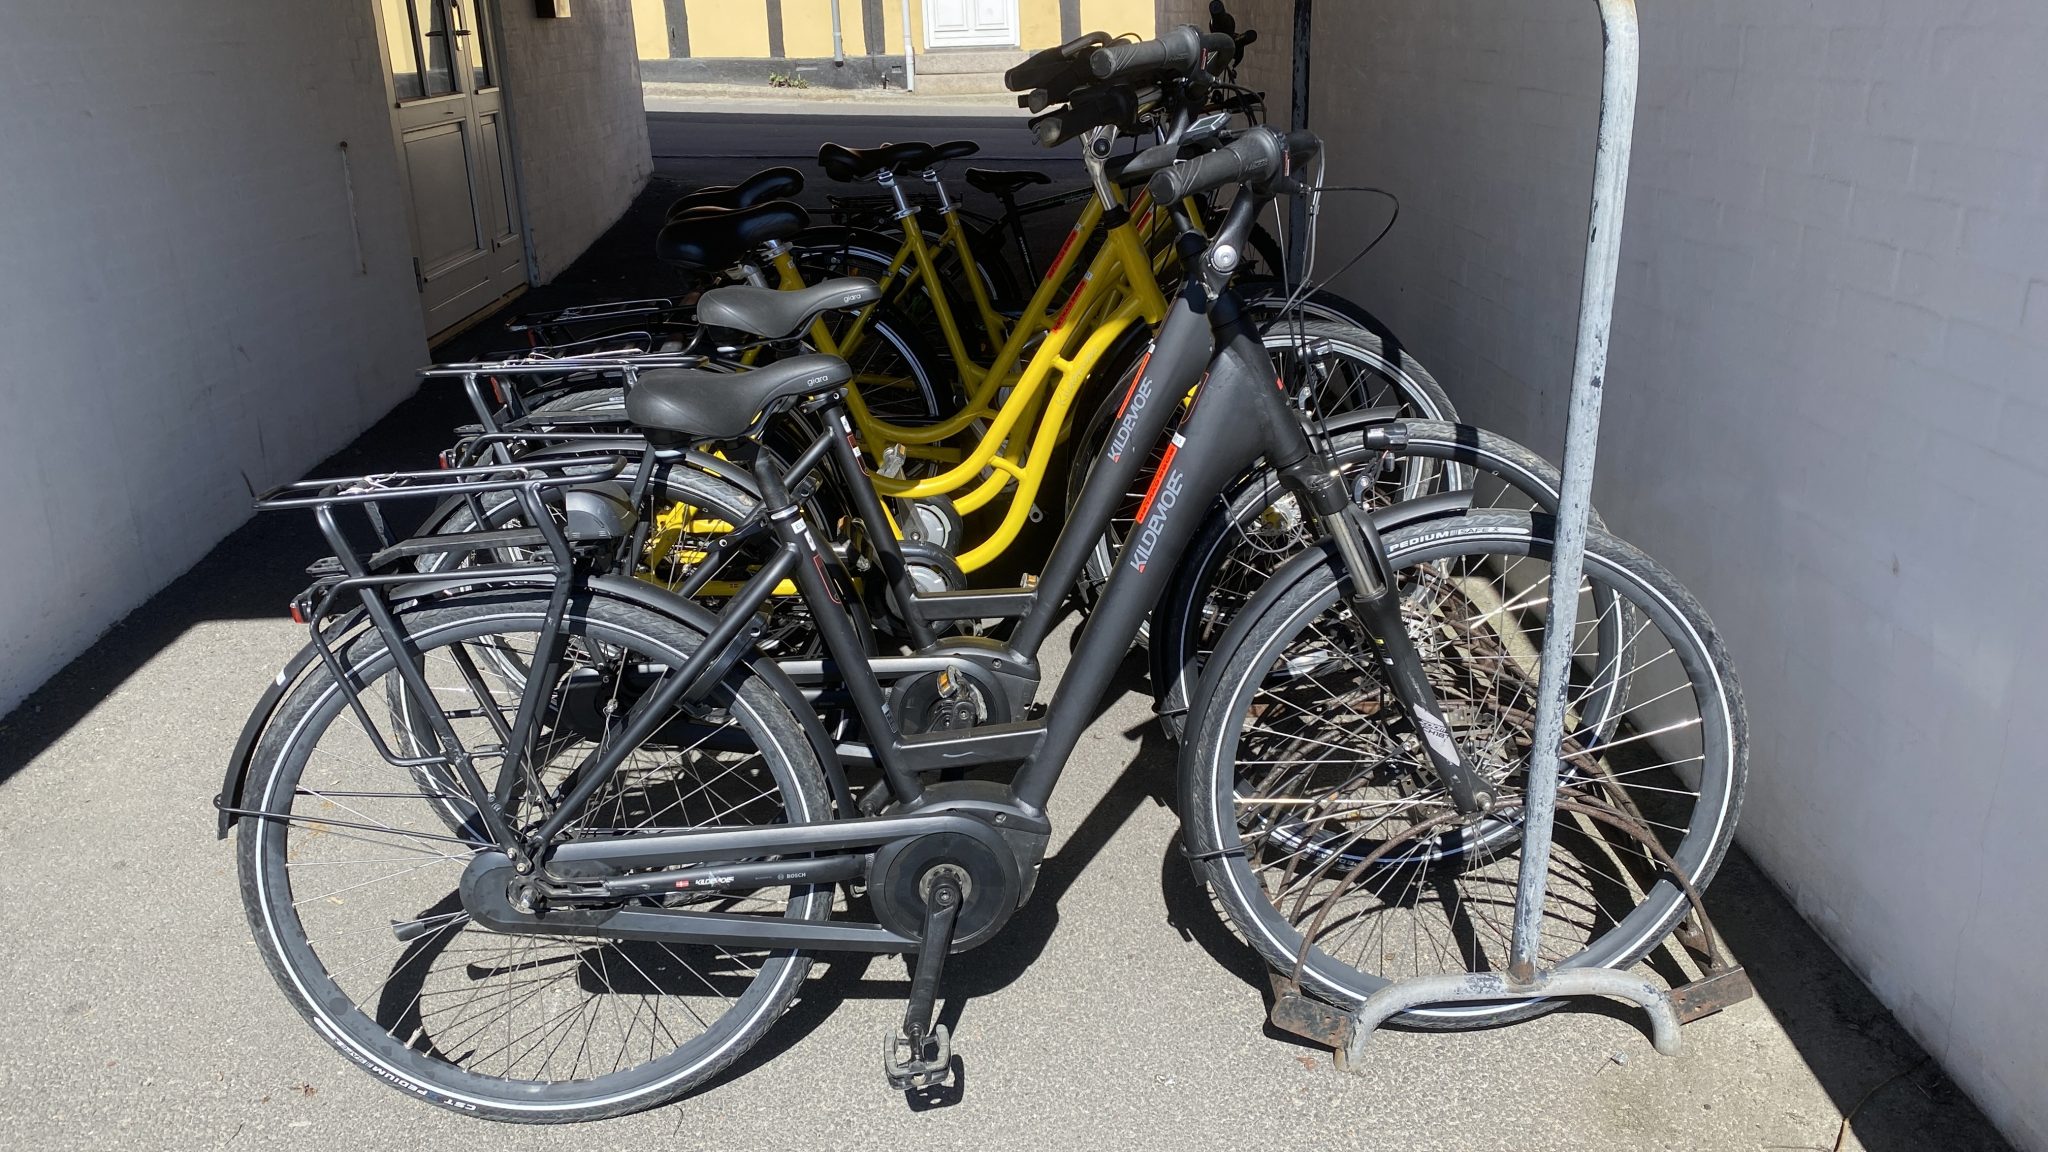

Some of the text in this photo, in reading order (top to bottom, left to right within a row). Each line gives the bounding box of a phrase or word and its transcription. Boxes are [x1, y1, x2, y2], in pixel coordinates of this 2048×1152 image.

[843, 292, 861, 303] giara
[807, 374, 828, 386] giara
[1130, 469, 1183, 573] KILDEMOES
[444, 1098, 476, 1111] CST
